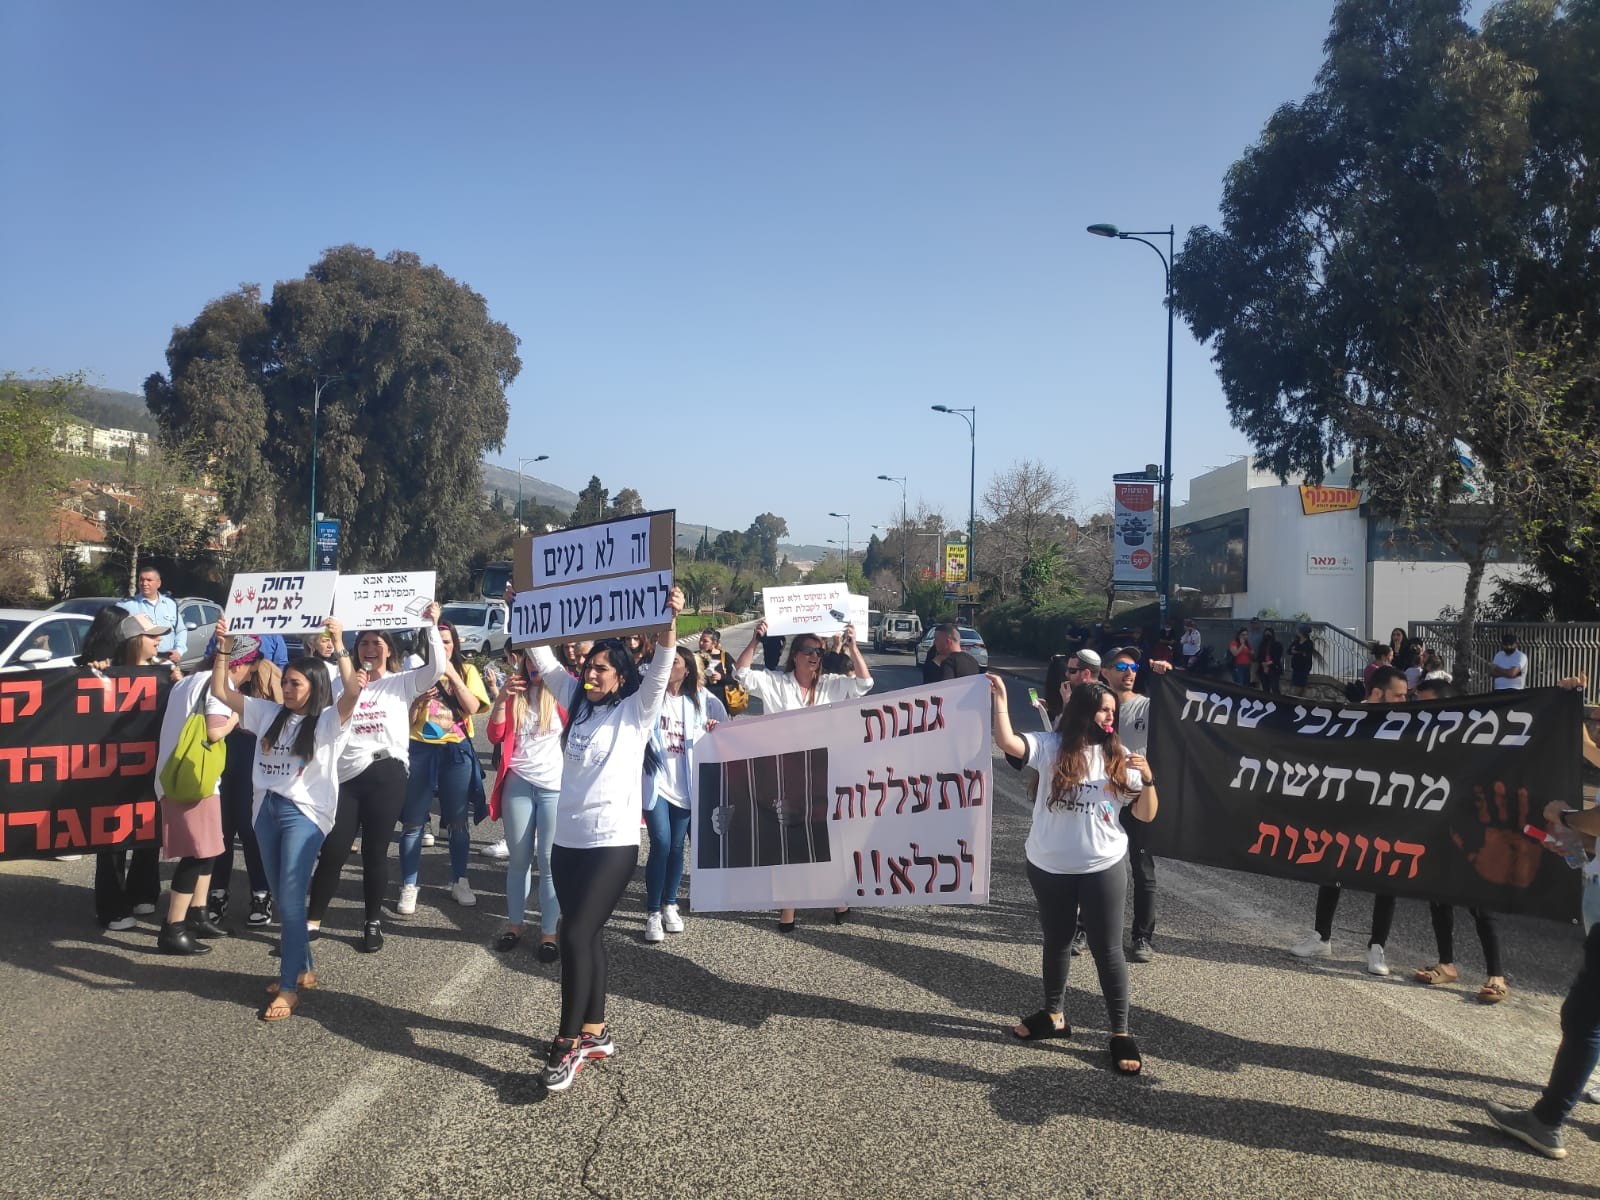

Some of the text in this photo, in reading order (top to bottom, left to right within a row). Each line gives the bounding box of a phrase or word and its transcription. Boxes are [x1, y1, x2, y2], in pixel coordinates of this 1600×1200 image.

[544, 528, 646, 576] זה לא נעים
[1311, 556, 1336, 566] מאר
[262, 576, 304, 593] החוק
[354, 586, 415, 600] המפלצות בגן
[363, 575, 408, 585] אמא אבא
[829, 590, 840, 599] לא
[256, 592, 303, 613] לא מגן
[373, 603, 393, 612] ולא
[514, 574, 669, 635] לראות מעון סגור
[230, 615, 322, 631] על ילדי הגן
[77, 676, 157, 714] מה
[860, 695, 945, 743] גננות
[1181, 689, 1534, 752] במקום הכי שמח
[832, 766, 985, 820] מתעללות
[1229, 756, 1450, 811] מתרחשות
[1248, 822, 1427, 879] הזוועות
